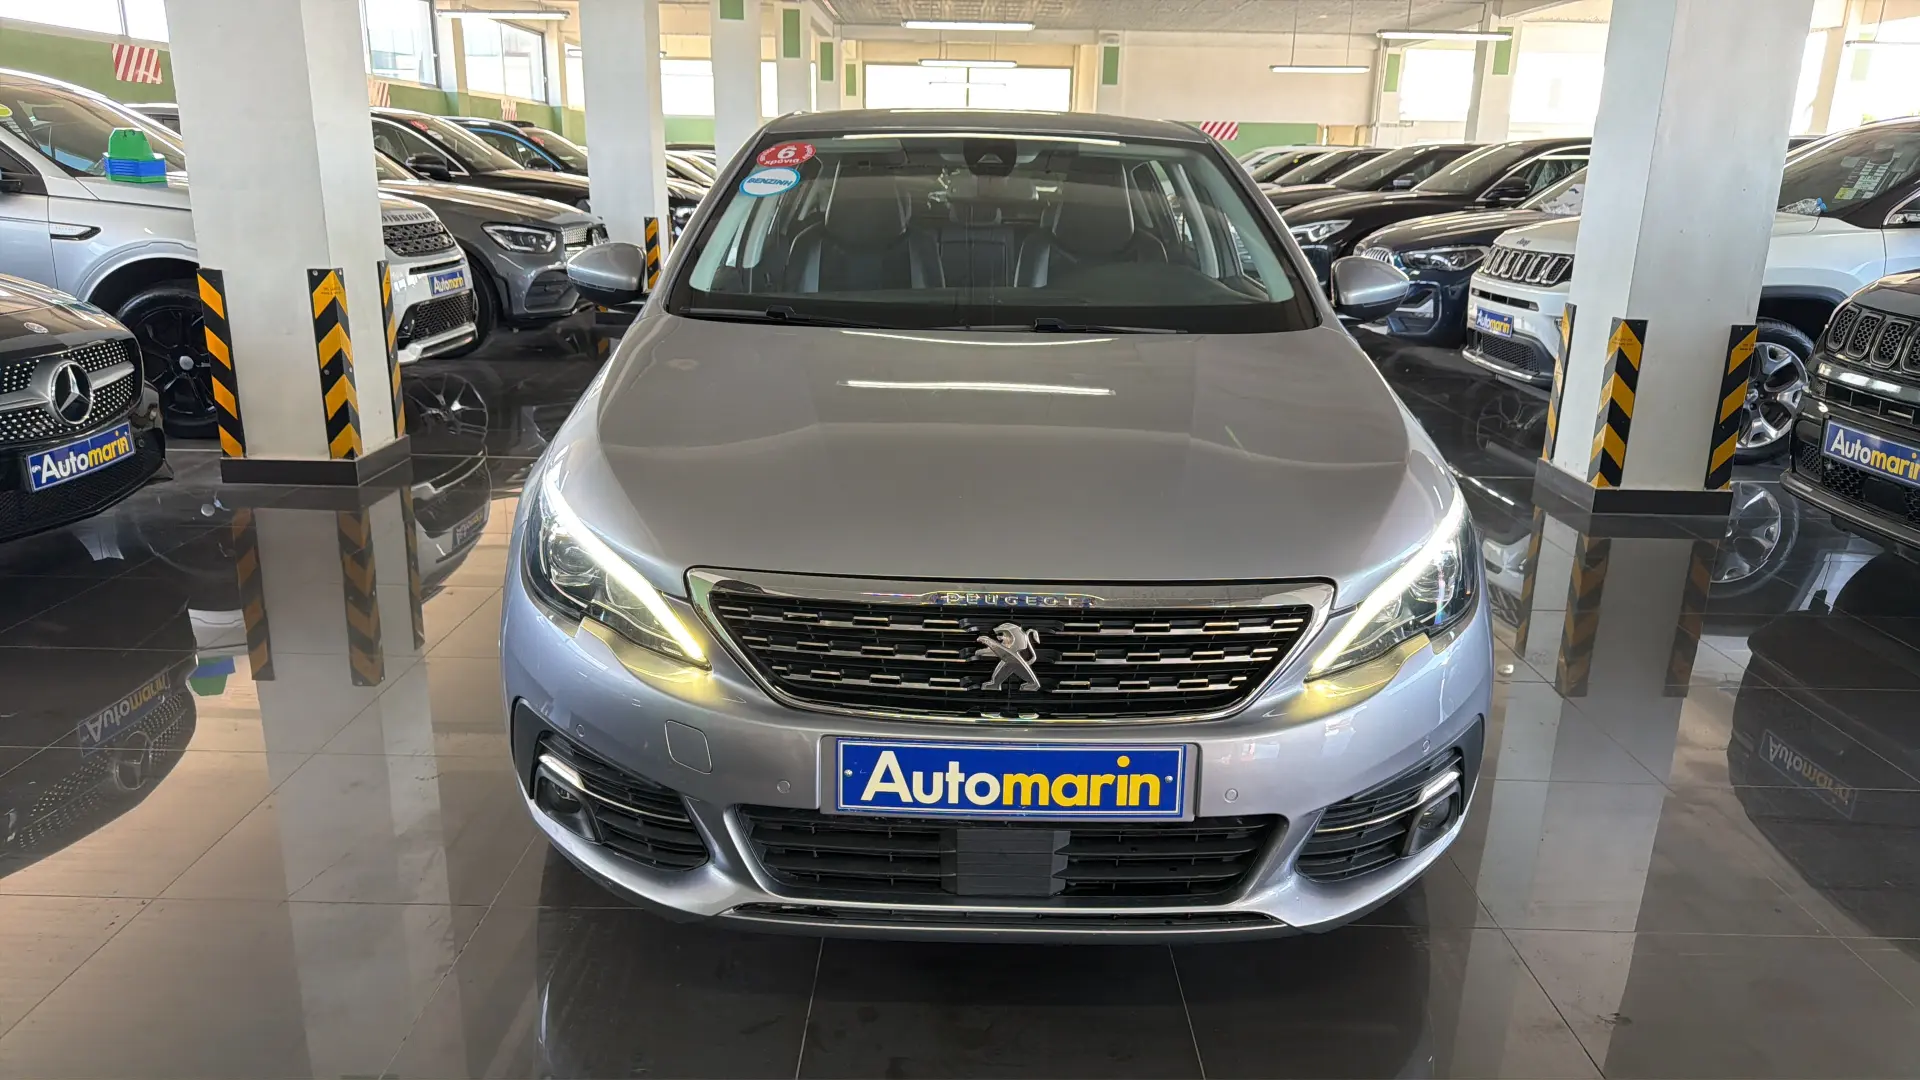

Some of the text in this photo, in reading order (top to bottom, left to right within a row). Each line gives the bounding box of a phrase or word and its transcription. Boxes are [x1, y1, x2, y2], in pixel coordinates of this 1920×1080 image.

[777, 147, 797, 159] 6
[1476, 309, 1511, 334] Automarin
[41, 430, 130, 484] Automarin
[945, 592, 1078, 606] PEUGEOT
[860, 751, 1160, 807] Automarin
